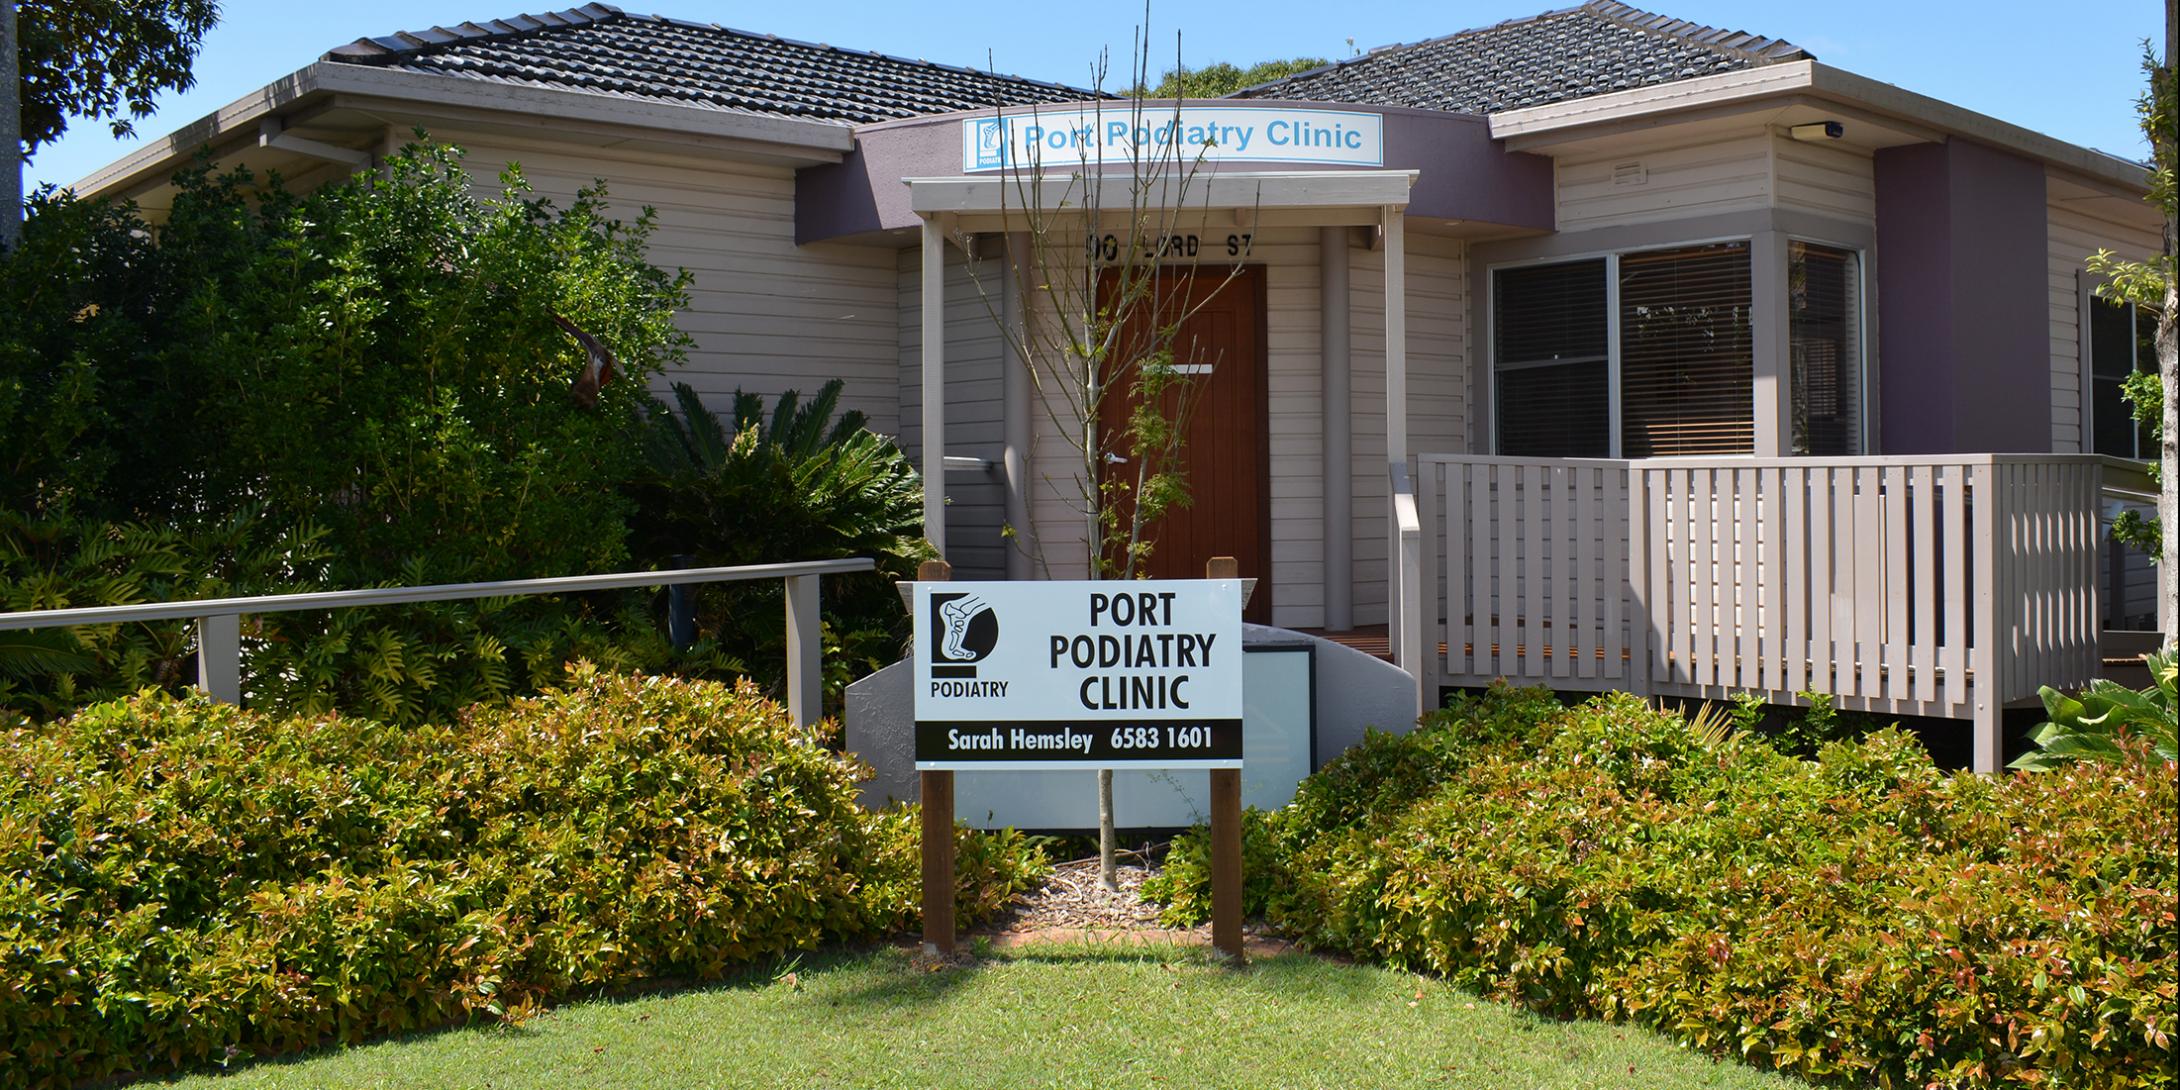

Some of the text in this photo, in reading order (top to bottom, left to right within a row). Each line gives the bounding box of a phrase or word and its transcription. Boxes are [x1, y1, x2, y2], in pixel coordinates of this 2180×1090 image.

[1024, 119, 1362, 153] Port Podiatry Clinic
[1227, 234, 1253, 257] ST
[1090, 592, 1176, 627] PORT
[1050, 633, 1217, 669] PODIATRY
[931, 681, 1009, 698] PODIATRY
[1079, 675, 1189, 711] CLINIC
[948, 727, 1212, 755] Sarah Hemsley 6583 1601
